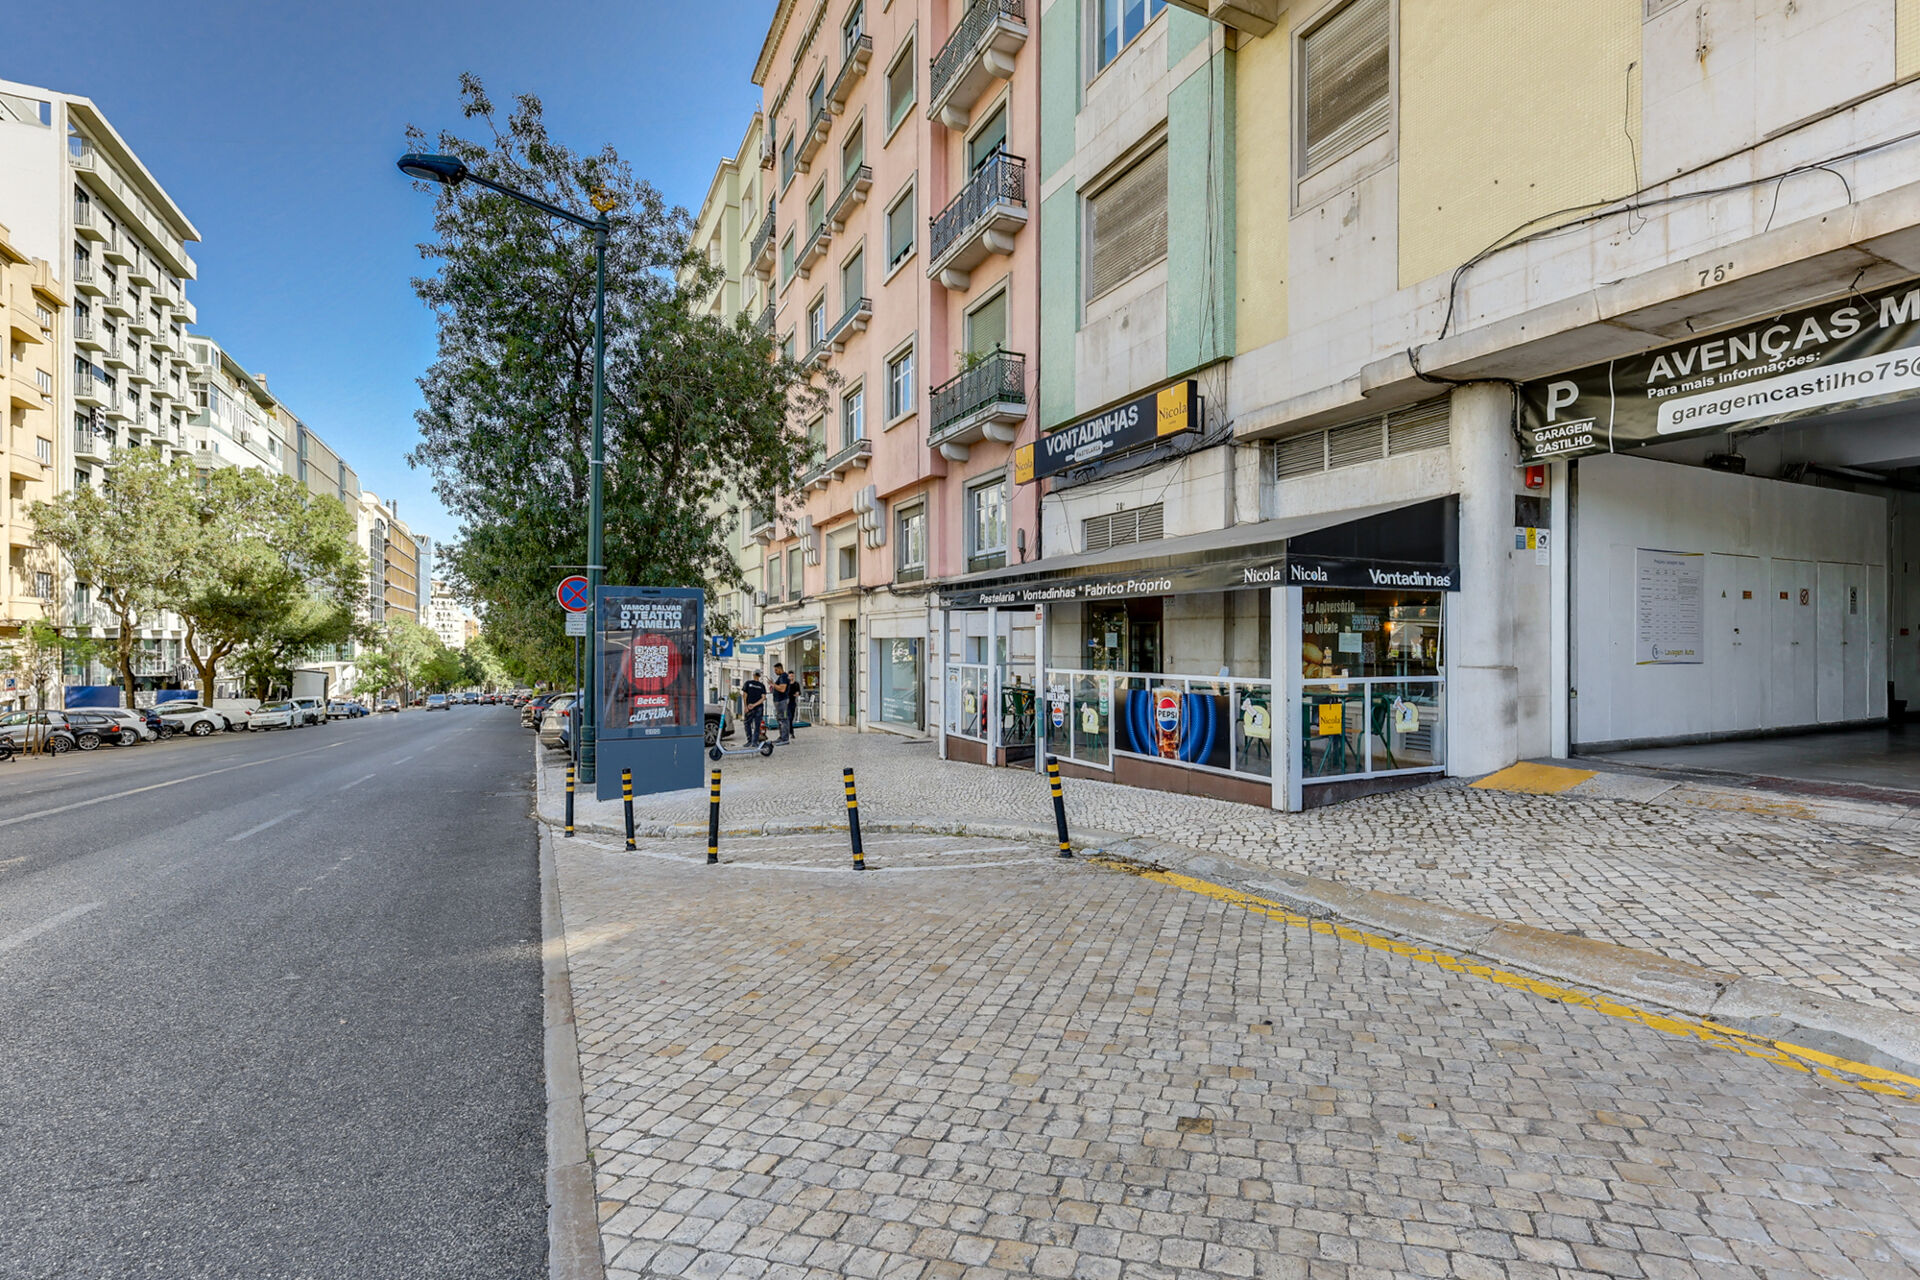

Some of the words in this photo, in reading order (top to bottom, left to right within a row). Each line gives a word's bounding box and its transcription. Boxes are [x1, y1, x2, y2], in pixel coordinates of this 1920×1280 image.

[1646, 307, 1861, 384] AVENÇAS
[1647, 386, 1677, 399] Para
[1681, 377, 1715, 392] mais
[1718, 351, 1820, 384] informações:
[1547, 380, 1579, 422] P
[1159, 403, 1187, 422] Nicola
[1046, 405, 1139, 456] VONTADINHAS
[1535, 422, 1593, 442] GARAGEM
[1535, 434, 1593, 454] CASTILHO
[1016, 459, 1033, 471] Nicola
[1244, 566, 1281, 583] Nicola
[1291, 564, 1328, 582] Nicola
[1368, 568, 1451, 588] Vontadinhas
[979, 591, 1015, 604] Pastelaria
[1023, 587, 1076, 601] Vontadinhas
[1085, 583, 1123, 597] Fabrico
[1126, 577, 1172, 594] Próprio
[620, 611, 631, 620] O
[633, 611, 682, 620] TEATRO
[637, 697, 666, 705] Betclic
[629, 709, 673, 722] CULTURA
[1158, 710, 1178, 719] PEPSI
[1320, 716, 1341, 725] Nicola
